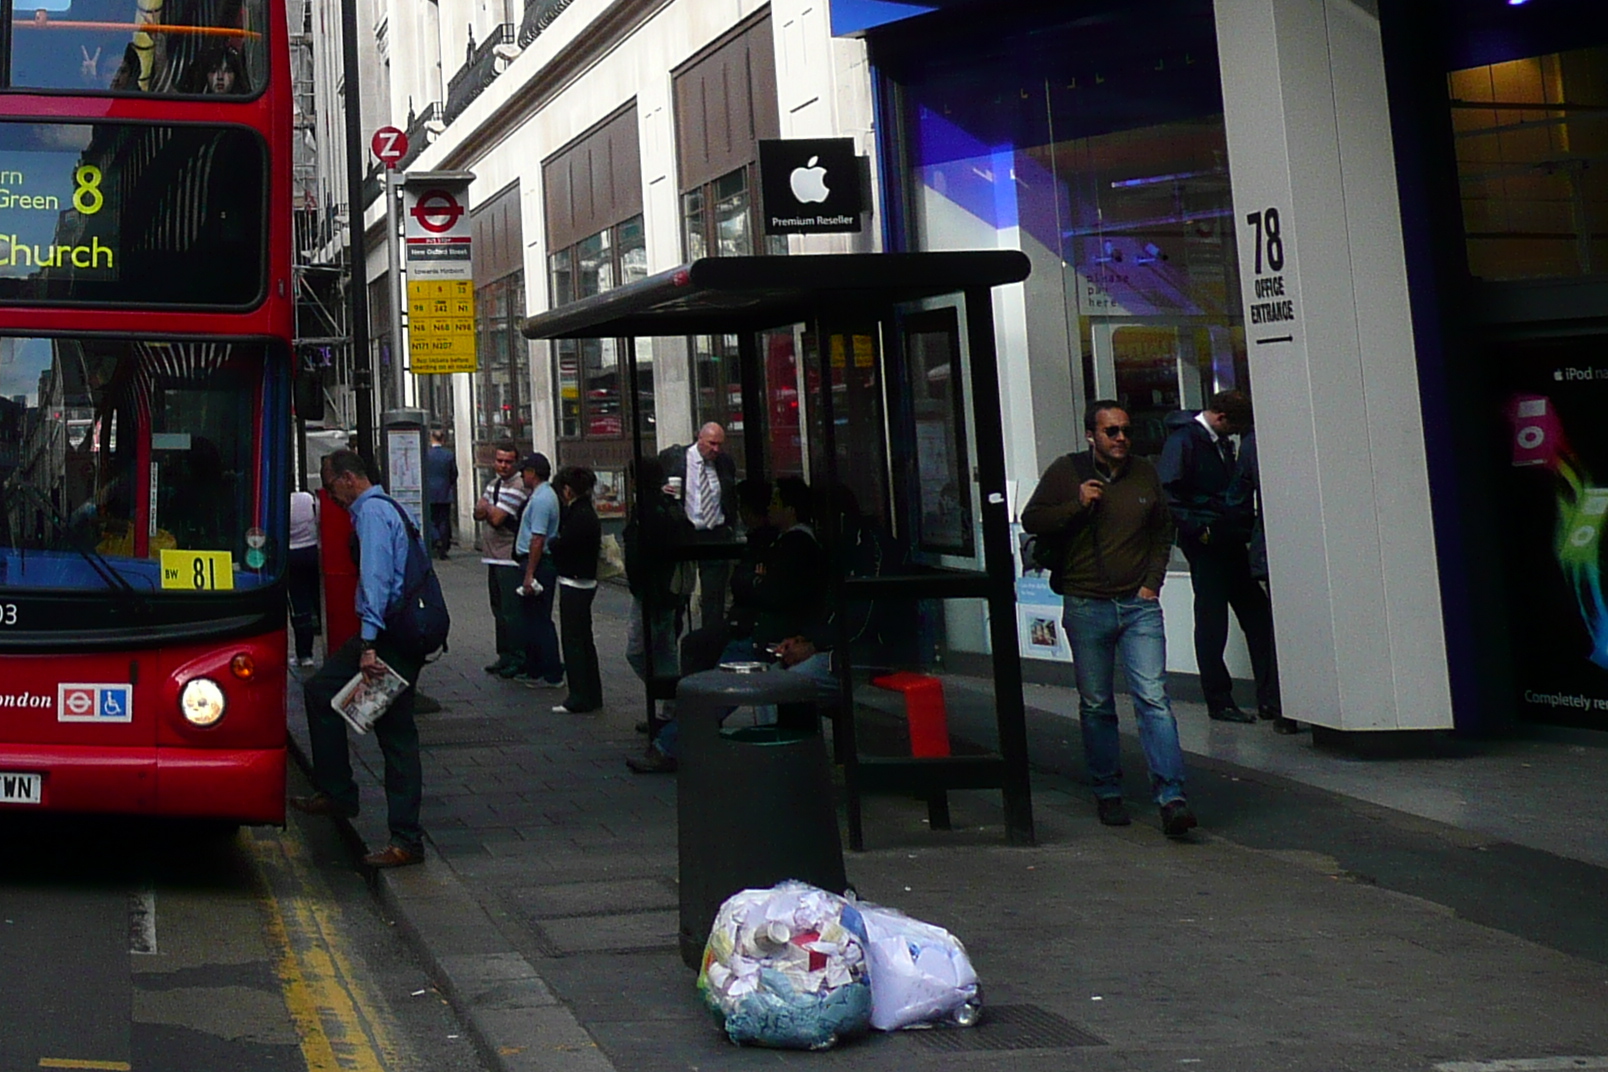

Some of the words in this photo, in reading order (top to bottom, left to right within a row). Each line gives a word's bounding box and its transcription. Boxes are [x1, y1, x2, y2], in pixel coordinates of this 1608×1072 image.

[379, 132, 400, 157] Z
[72, 165, 104, 215] 8
[772, 216, 815, 227] Premium
[816, 215, 853, 225] Reseller
[1247, 208, 1284, 274] 78
[1255, 276, 1285, 299] OFFICE
[1089, 298, 1117, 307] here
[1251, 300, 1294, 324] ENTRANCE
[1565, 366, 1593, 381] iPod
[165, 569, 178, 579] BW
[193, 557, 215, 590] 81
[1524, 689, 1591, 712] Completely
